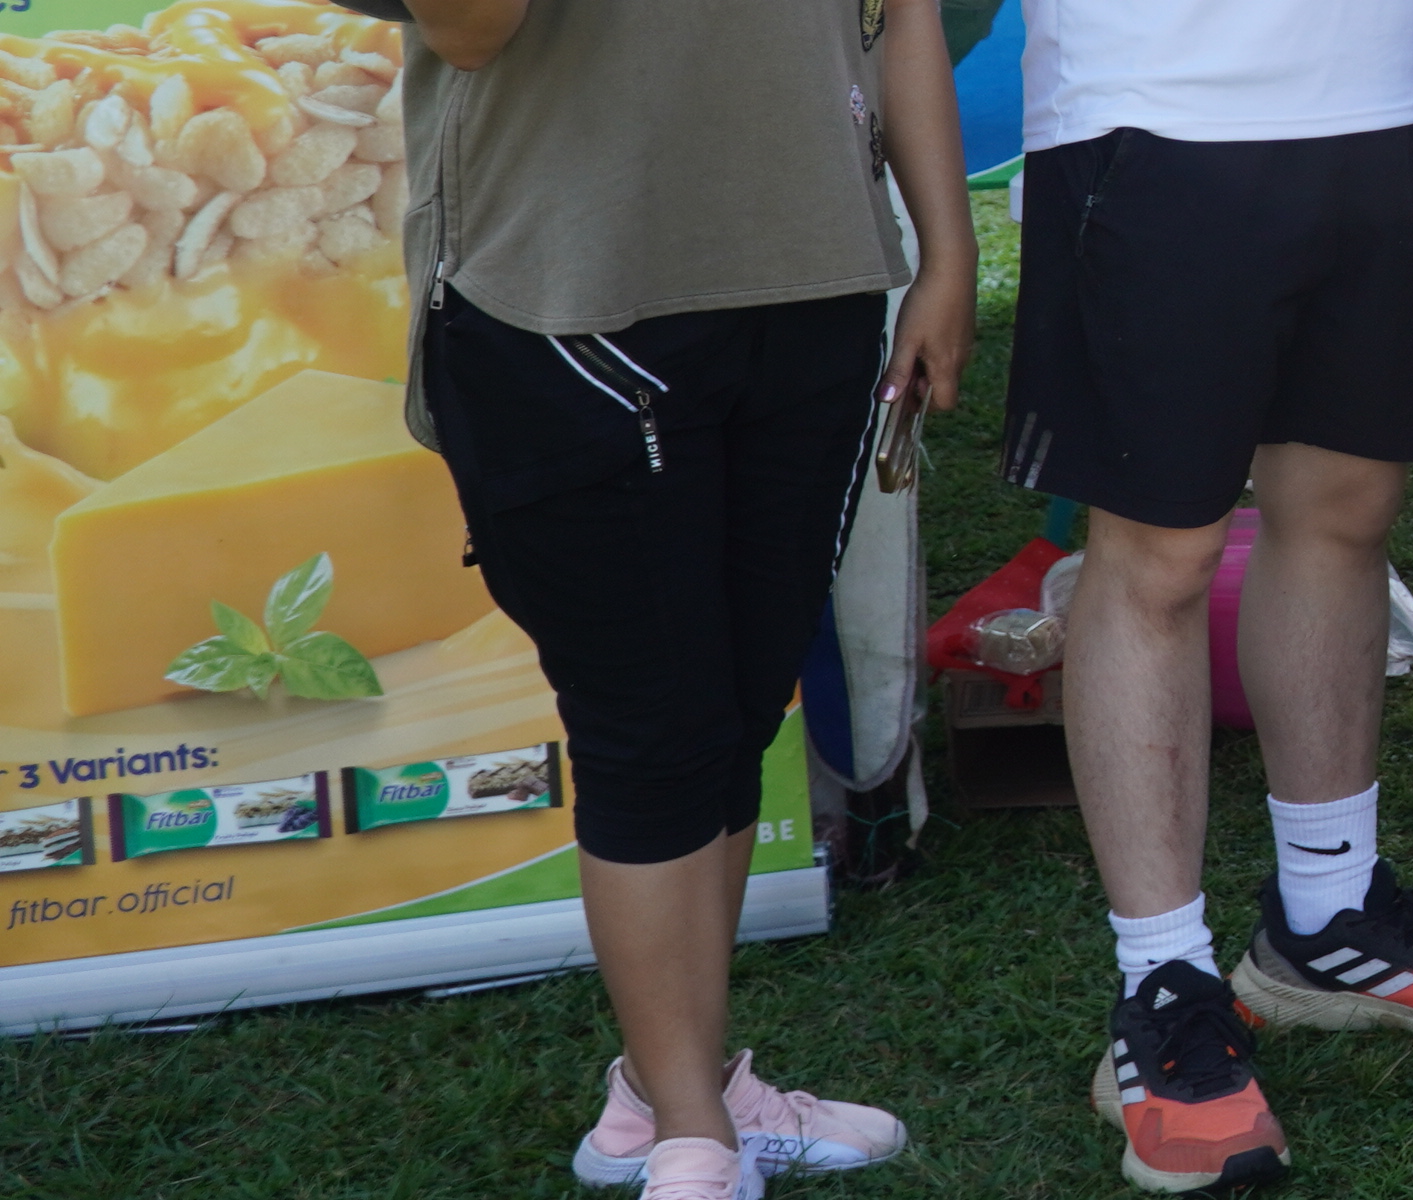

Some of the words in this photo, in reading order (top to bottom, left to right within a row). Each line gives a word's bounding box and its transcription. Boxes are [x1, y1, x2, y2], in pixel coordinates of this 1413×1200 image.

[19, 763, 40, 789] 3
[48, 742, 219, 785] Variants:
[379, 780, 445, 804] Fitbar
[145, 806, 214, 832] Fitbar
